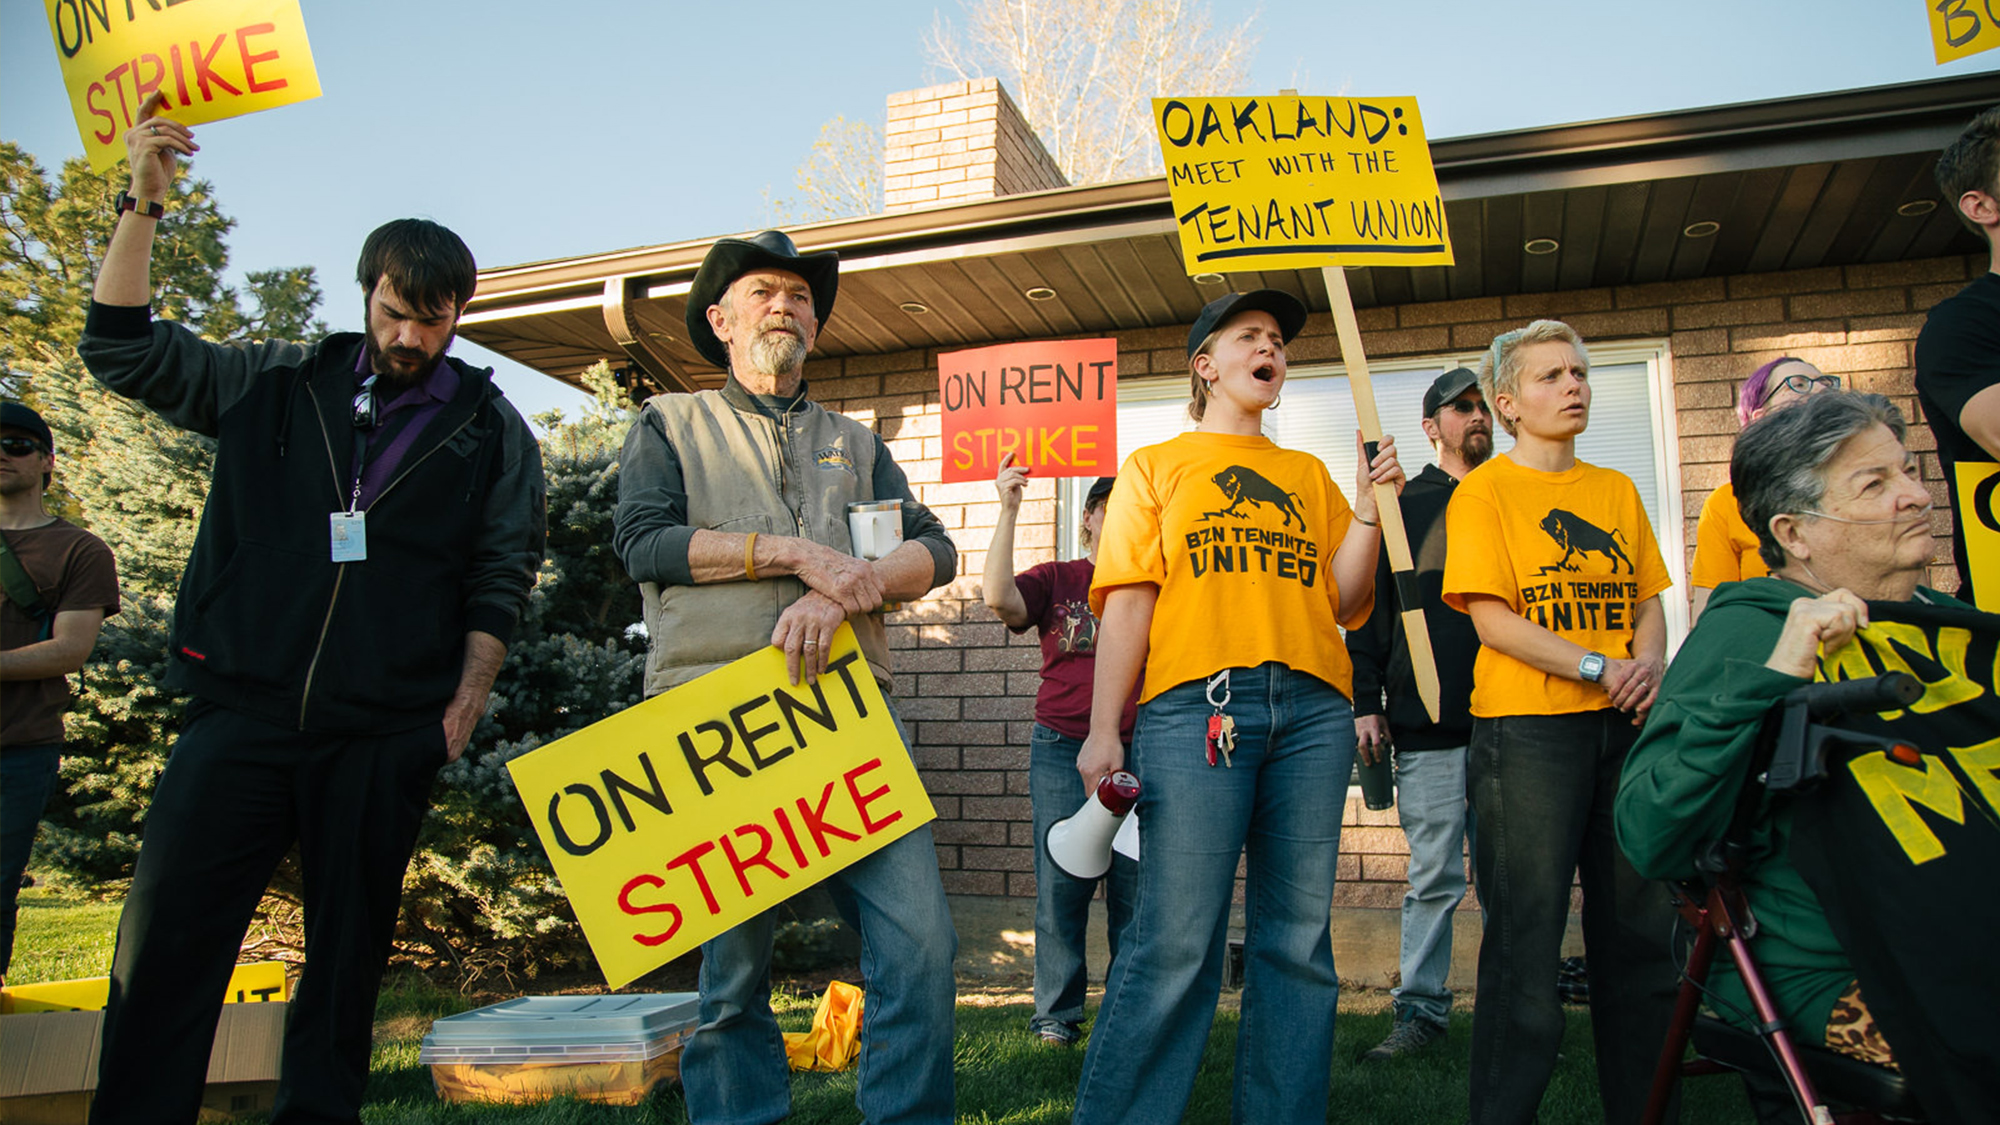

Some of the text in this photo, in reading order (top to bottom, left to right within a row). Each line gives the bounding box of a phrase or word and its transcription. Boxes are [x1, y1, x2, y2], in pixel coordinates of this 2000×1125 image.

[56, 0, 111, 58] ON
[87, 22, 289, 145] STRIKE
[1162, 99, 1408, 147] OAKLAND:
[1172, 150, 1399, 187] MEET WITH THE
[1179, 195, 1444, 244] TENANT UNION
[945, 361, 1114, 411] ON RENT
[953, 425, 1099, 470] STRIKE
[1185, 526, 1318, 558] BZN TENANTS
[1189, 545, 1318, 588] UNITED
[1521, 582, 1638, 604] BZN TENANTS
[548, 650, 868, 857] ON RENT
[618, 757, 903, 947] STRIKE
